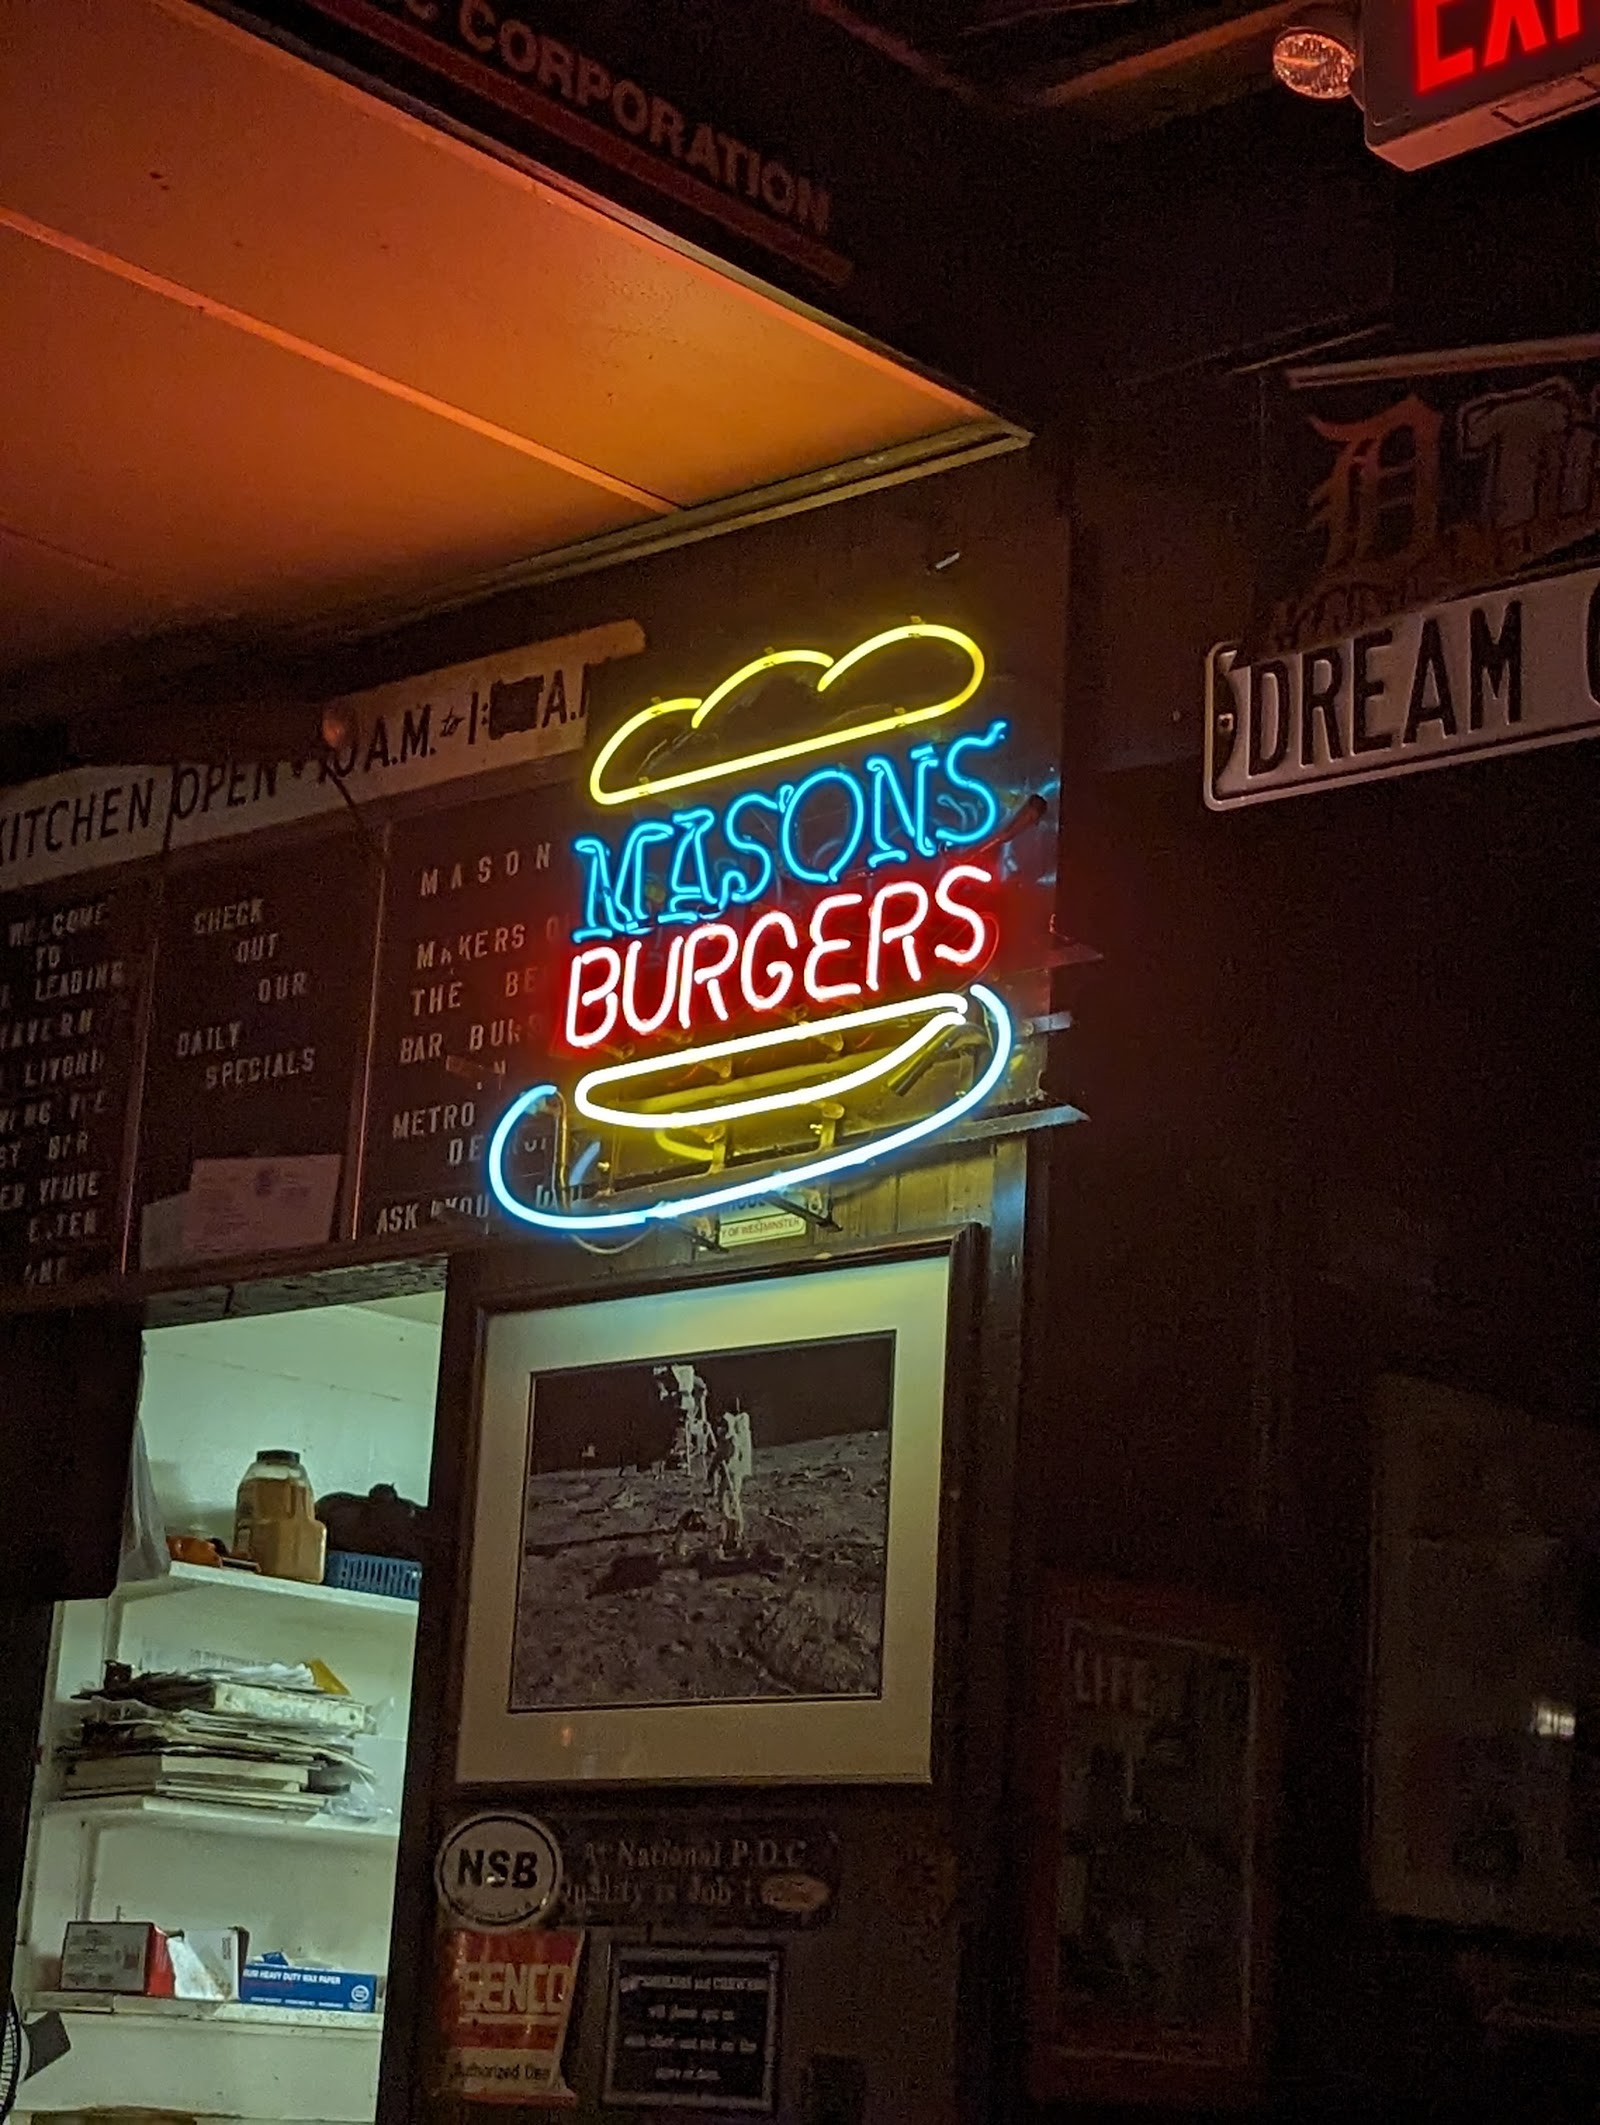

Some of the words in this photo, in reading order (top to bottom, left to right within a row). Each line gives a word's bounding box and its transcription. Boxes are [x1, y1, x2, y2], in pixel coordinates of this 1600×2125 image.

[458, 0, 832, 232] CORPORATION
[1247, 600, 1522, 778] DREAM
[171, 762, 279, 821] OPEN
[572, 720, 1008, 942] MASONS
[194, 898, 264, 934] CHECK
[36, 945, 60, 972] TO
[235, 932, 279, 965] OUT
[416, 924, 527, 970] MAKERS
[565, 865, 993, 1048] BURGERS
[257, 971, 308, 1004] OUR
[410, 981, 463, 1016] THE
[176, 1020, 243, 1059] DAILY
[400, 1032, 443, 1064] BAR
[205, 1047, 316, 1089] SPECIALS
[392, 1101, 475, 1138] METRO
[376, 1203, 418, 1235] ASK
[458, 1848, 539, 1889] NSB
